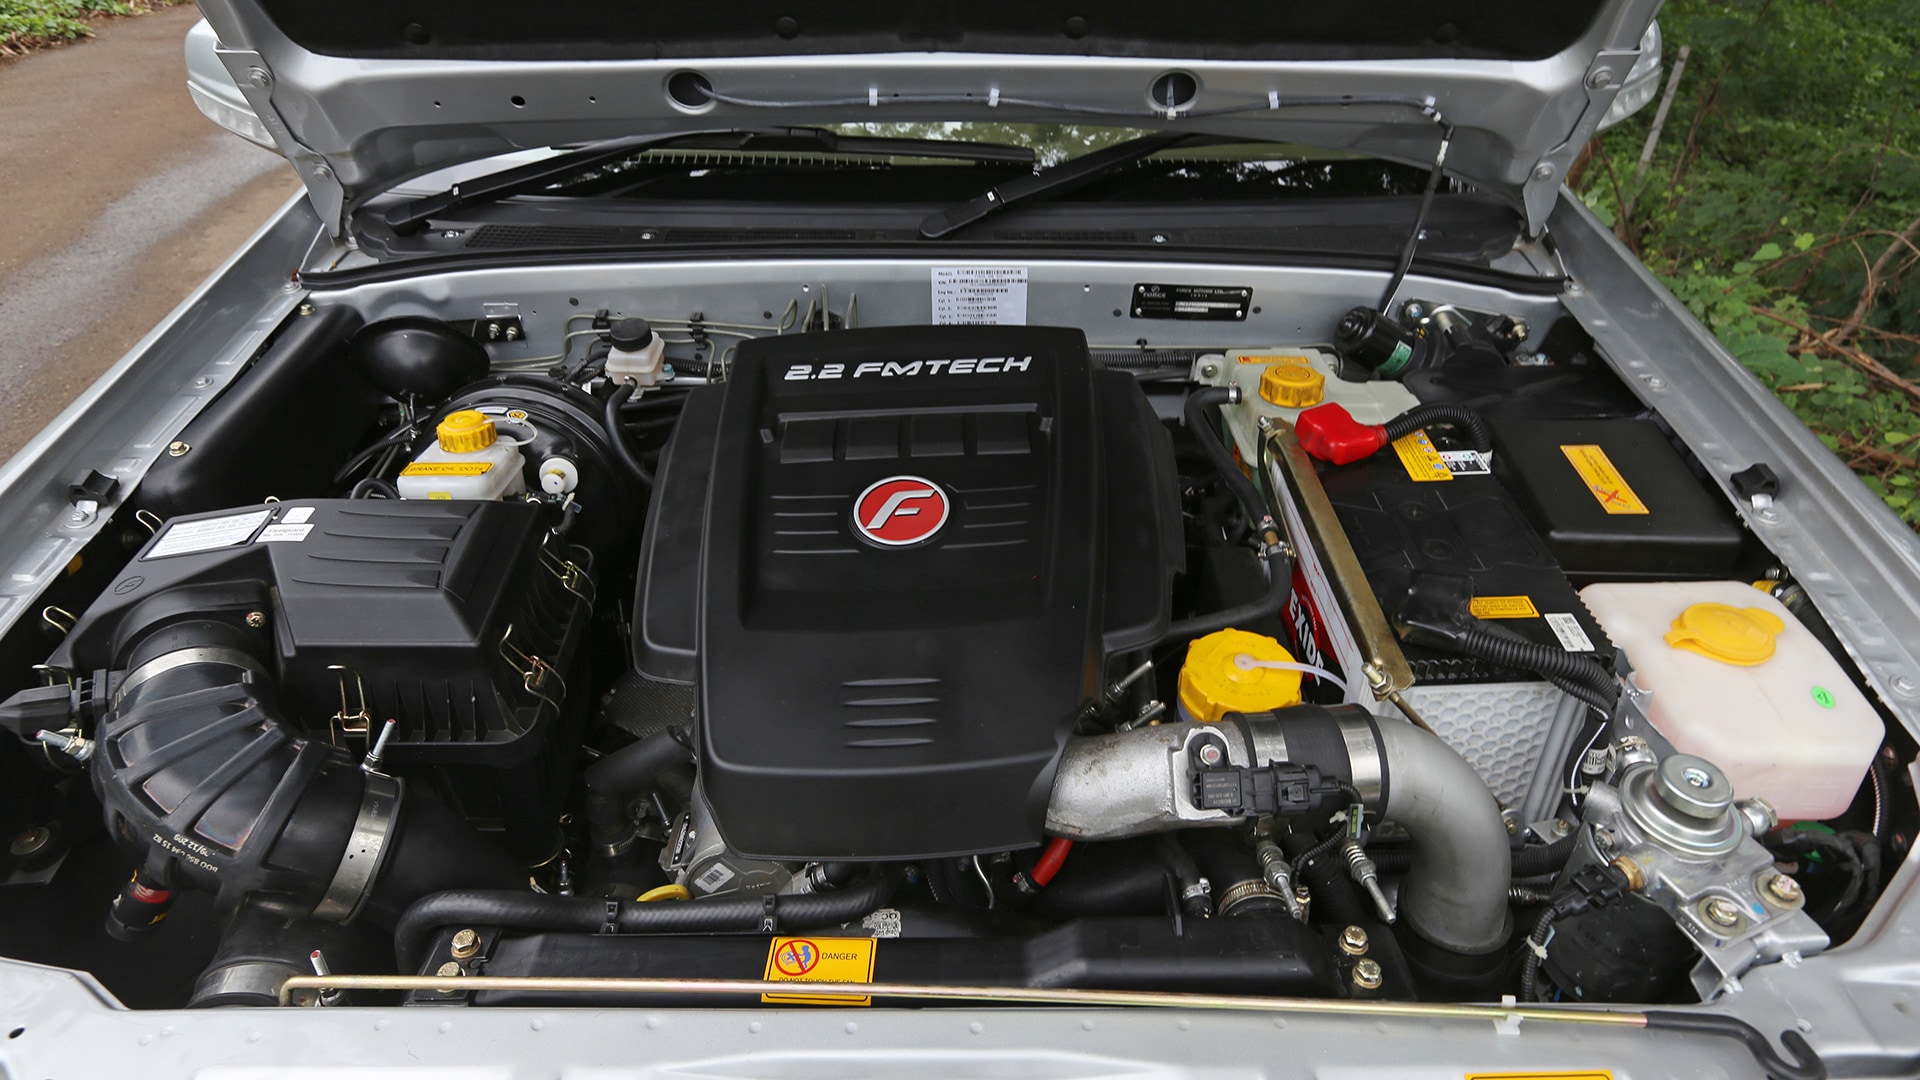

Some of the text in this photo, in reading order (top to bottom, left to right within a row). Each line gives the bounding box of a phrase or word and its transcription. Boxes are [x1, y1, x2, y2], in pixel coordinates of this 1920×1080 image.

[783, 355, 1032, 380] 2.2 FMTECH
[1289, 587, 1324, 687] EXIDE
[821, 952, 858, 961] DANGER
